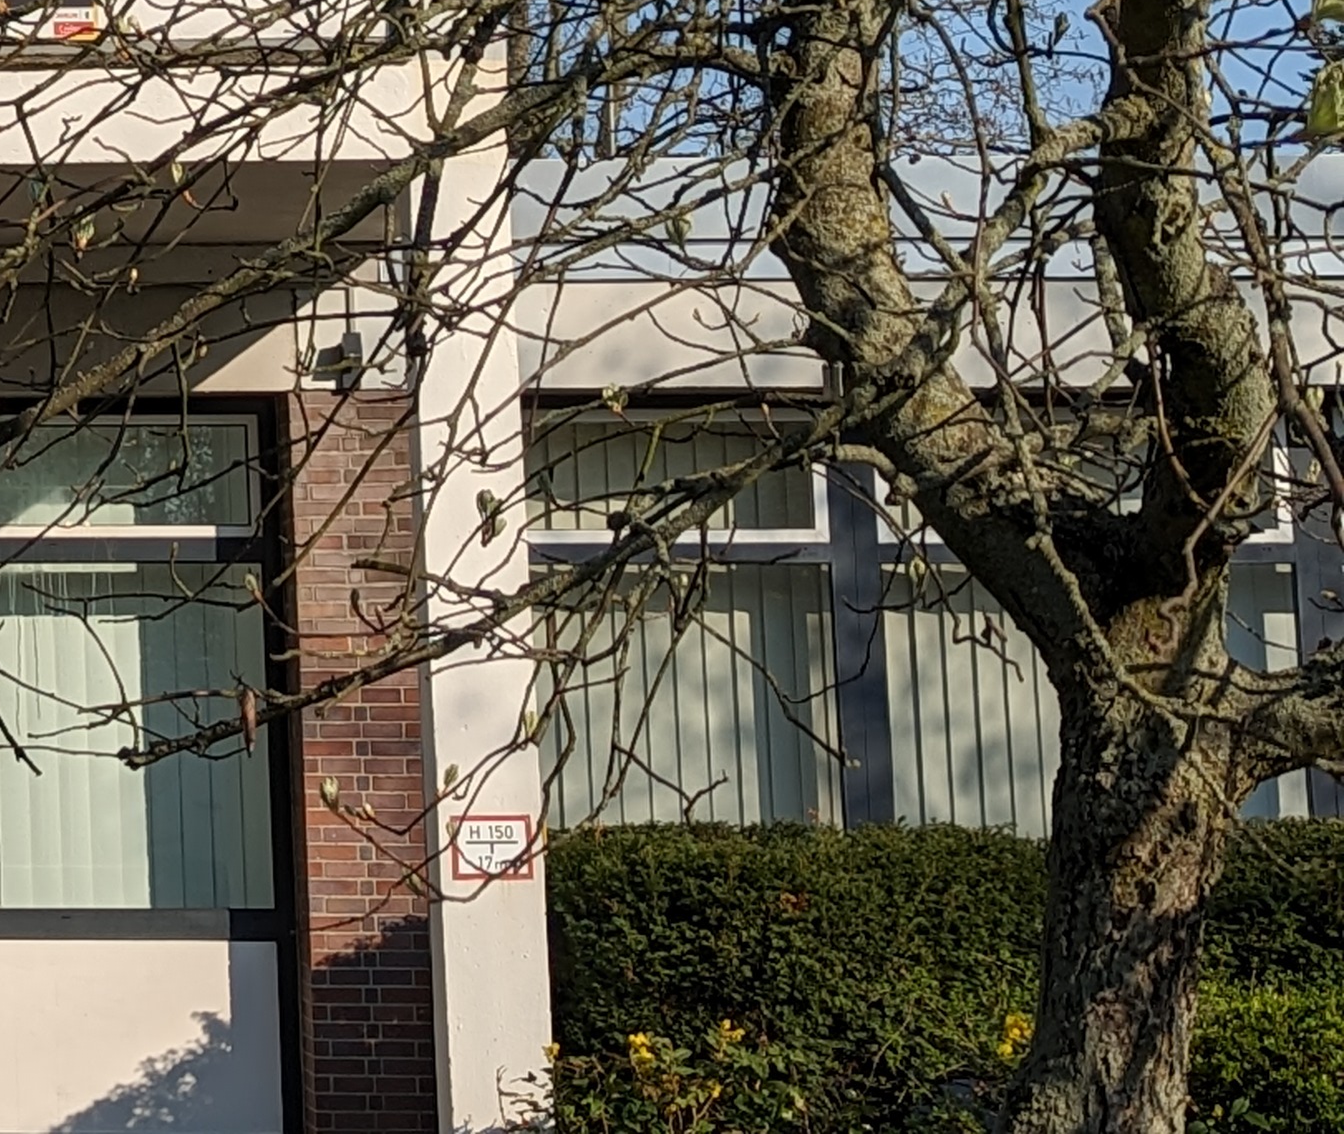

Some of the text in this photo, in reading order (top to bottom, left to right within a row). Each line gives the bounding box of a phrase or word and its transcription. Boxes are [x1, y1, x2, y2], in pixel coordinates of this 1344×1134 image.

[469, 825, 514, 839] H 150
[478, 855, 492, 870] 17
